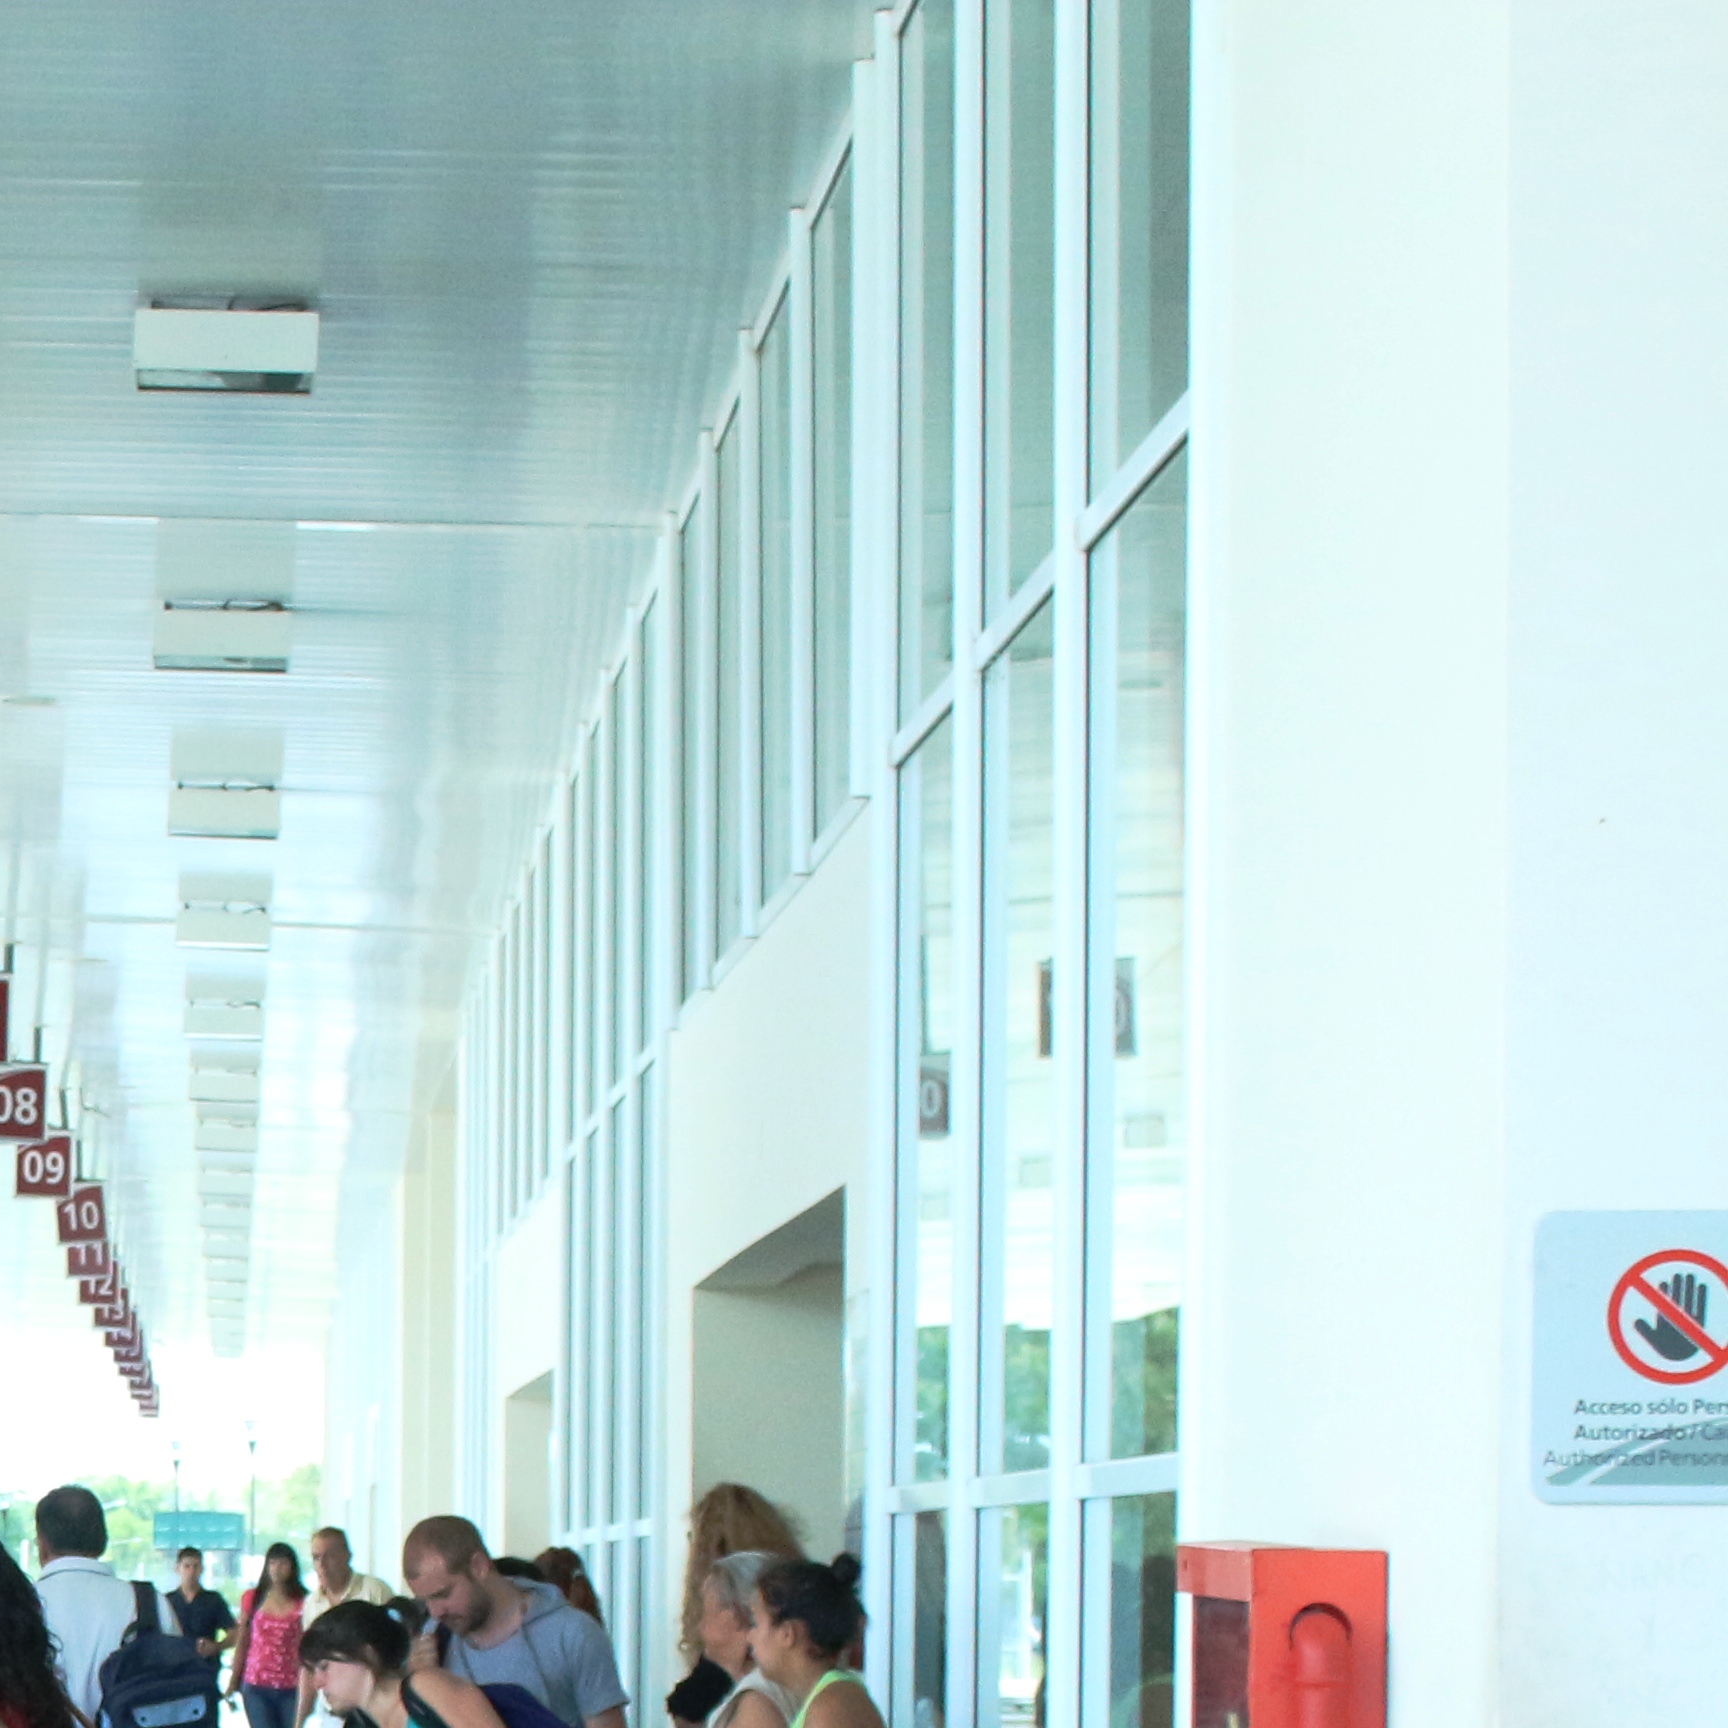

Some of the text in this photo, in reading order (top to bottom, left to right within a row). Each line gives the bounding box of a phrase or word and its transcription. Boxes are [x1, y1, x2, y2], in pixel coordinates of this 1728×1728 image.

[22, 1149, 66, 1185] 09
[63, 1201, 100, 1231] 10
[1573, 1398, 1642, 1415] Acceso
[1646, 1397, 1688, 1415] sólo
[1573, 1424, 1686, 1441] Autorizado
